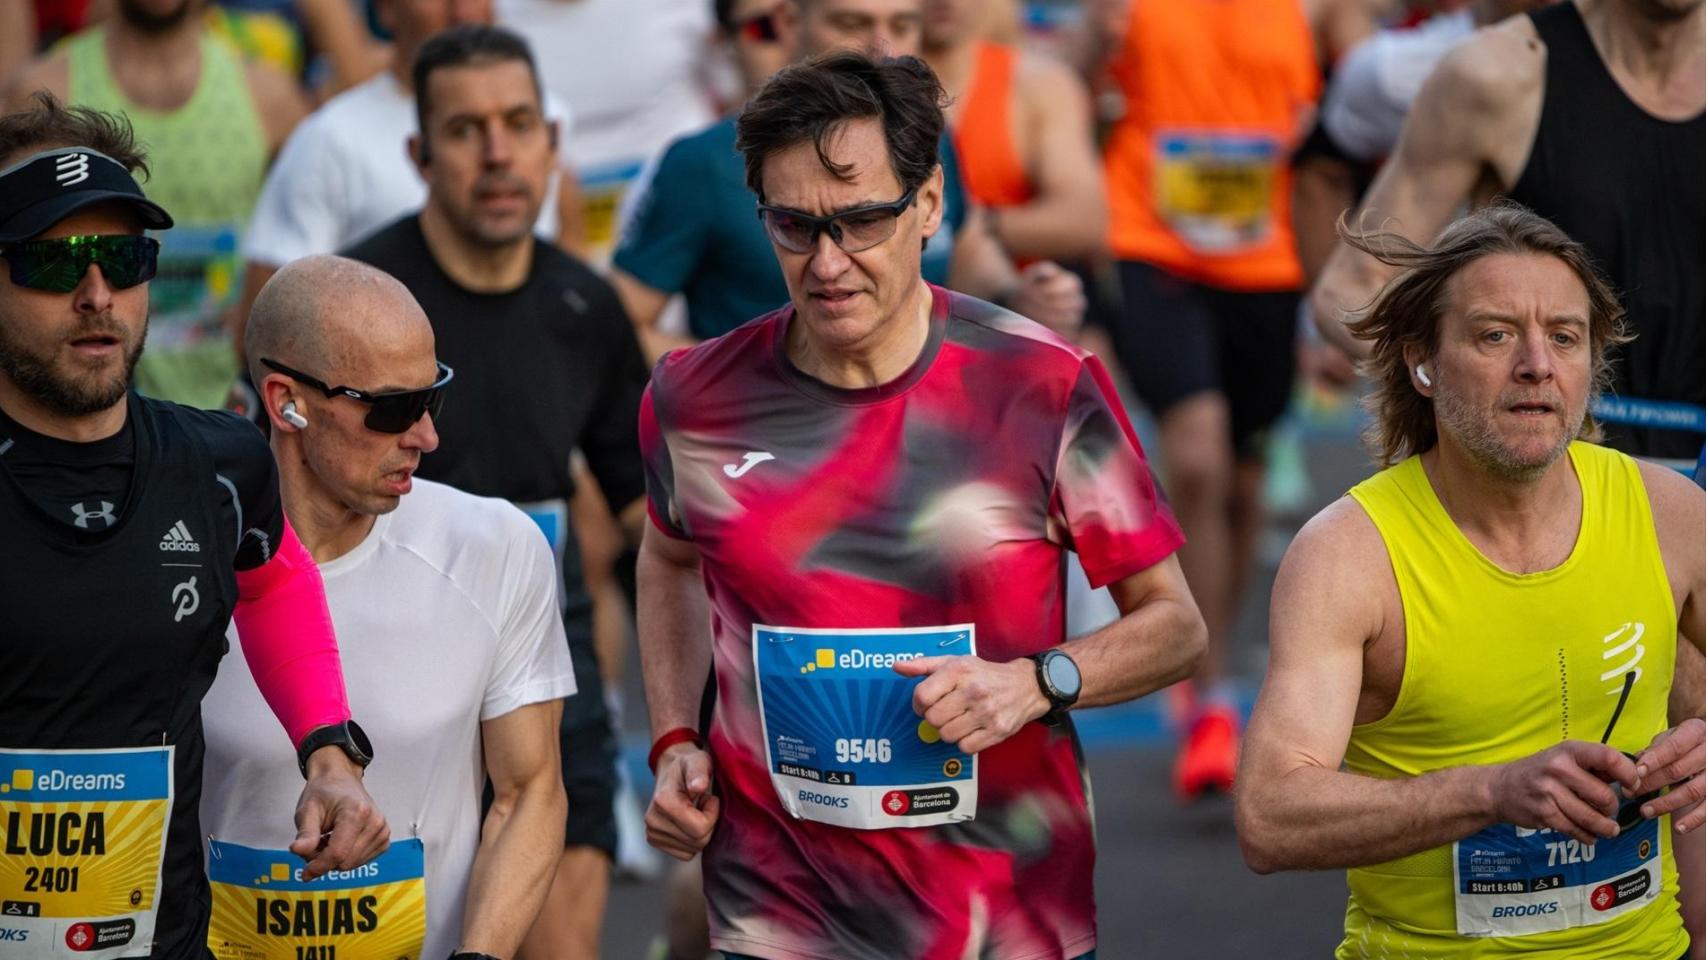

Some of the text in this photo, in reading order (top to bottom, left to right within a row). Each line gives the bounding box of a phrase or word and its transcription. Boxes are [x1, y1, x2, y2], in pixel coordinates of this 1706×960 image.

[159, 539, 200, 552] adidas
[839, 649, 925, 668] eDream
[835, 738, 891, 763] 9546
[37, 769, 125, 791] eDreams
[798, 790, 849, 808] BROOKS
[913, 800, 951, 808] Barcelona
[5, 811, 106, 856] LUCA
[1545, 838, 1596, 867] 7120
[24, 866, 79, 893] 2401
[1472, 882, 1524, 892] Start 8:40h
[1618, 882, 1646, 898] Barcelona
[27, 904, 34, 915] A
[256, 895, 378, 937] ISAIAS
[1492, 902, 1558, 918] BROOKS
[98, 931, 129, 943] Barcelona
